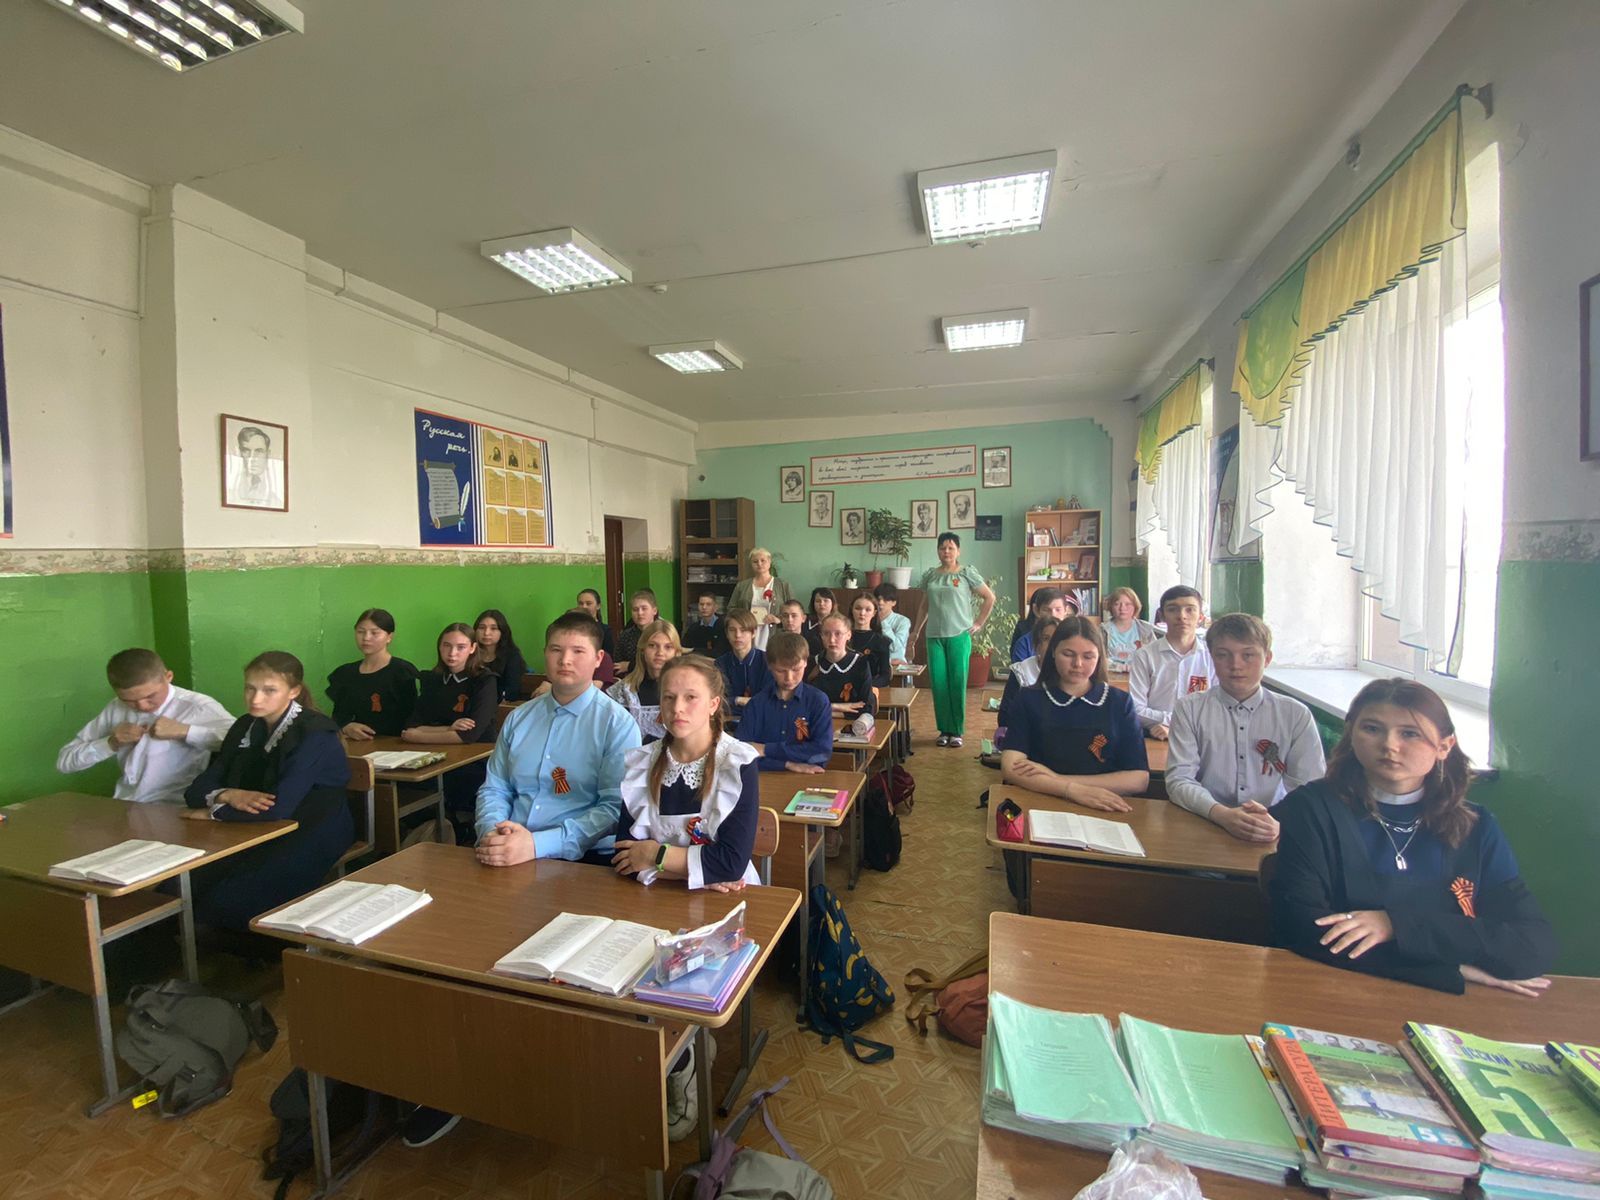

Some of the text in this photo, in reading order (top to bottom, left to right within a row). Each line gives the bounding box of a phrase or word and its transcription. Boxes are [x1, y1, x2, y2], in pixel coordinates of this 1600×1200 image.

[421, 419, 465, 439] Русская
[1283, 1038, 1343, 1127] ЛИТЕРАТУРА
[1458, 1058, 1574, 1148] 5
[1417, 1126, 1439, 1144] 5
